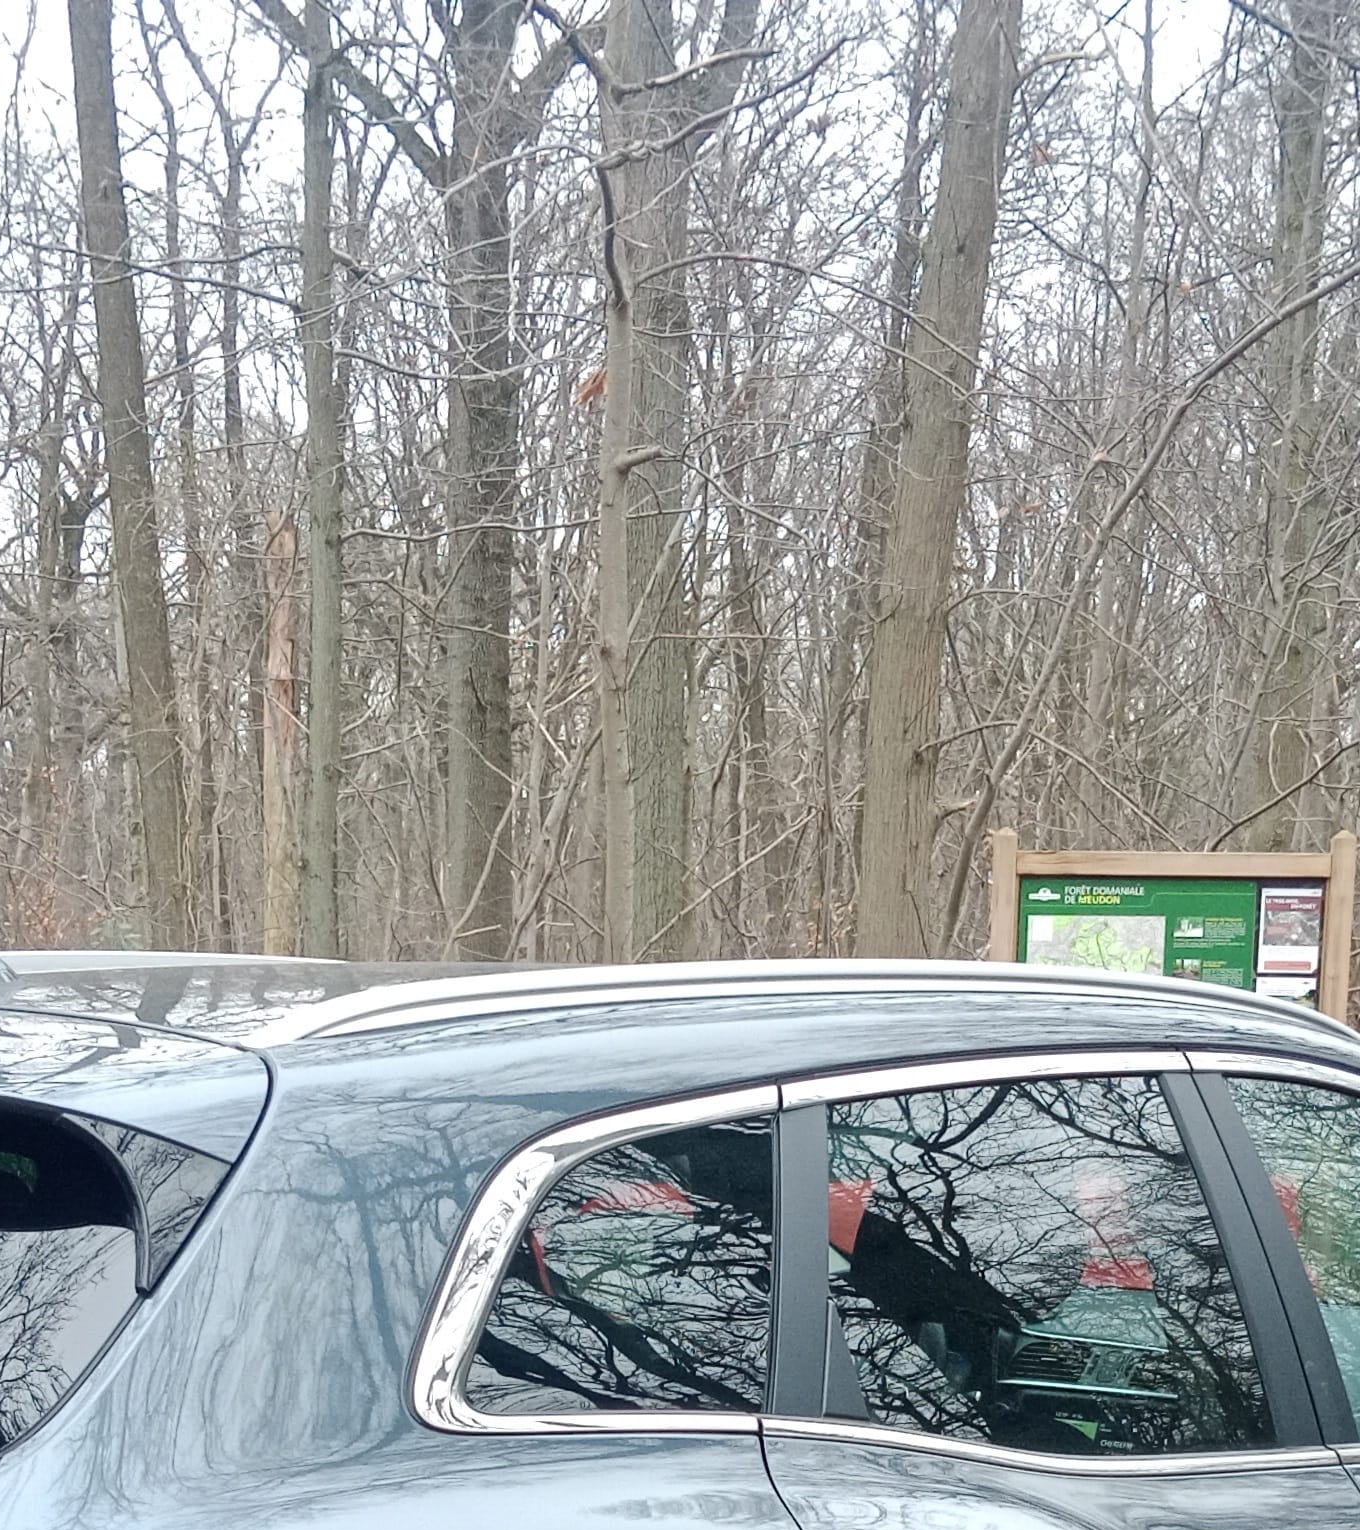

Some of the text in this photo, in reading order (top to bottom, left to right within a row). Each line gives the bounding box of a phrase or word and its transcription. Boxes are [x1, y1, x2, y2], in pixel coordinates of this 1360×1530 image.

[1064, 885, 1144, 896] FORÊT DOMANIALE
[1064, 895, 1076, 905] DE
[1078, 895, 1121, 905] MEUDON
